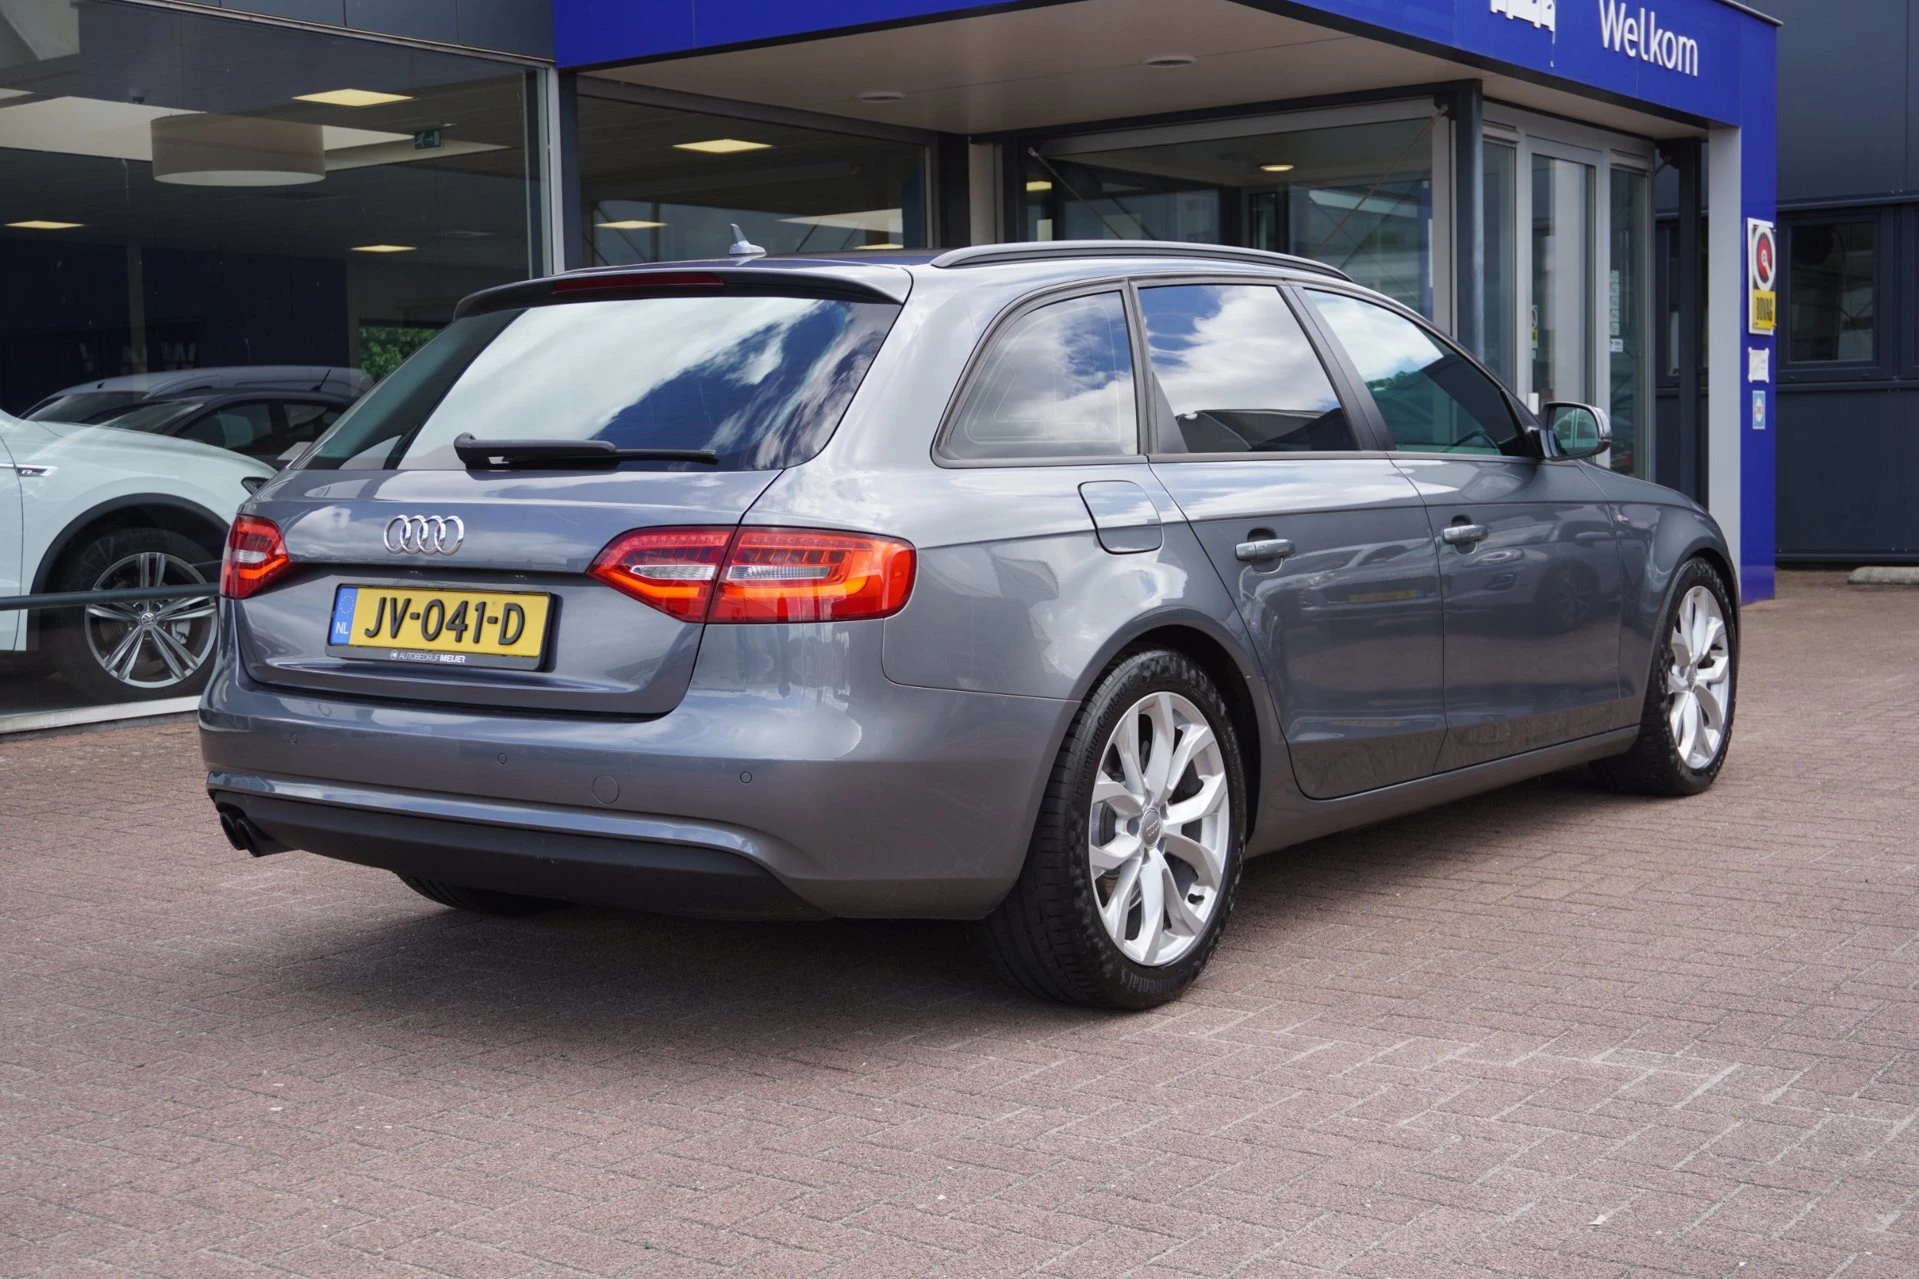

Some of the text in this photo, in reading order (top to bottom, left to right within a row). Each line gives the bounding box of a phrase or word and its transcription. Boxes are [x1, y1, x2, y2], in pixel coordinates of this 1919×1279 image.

[1599, 1, 1698, 77] Welkom
[335, 621, 349, 635] NL
[364, 596, 526, 646] JV-041-D
